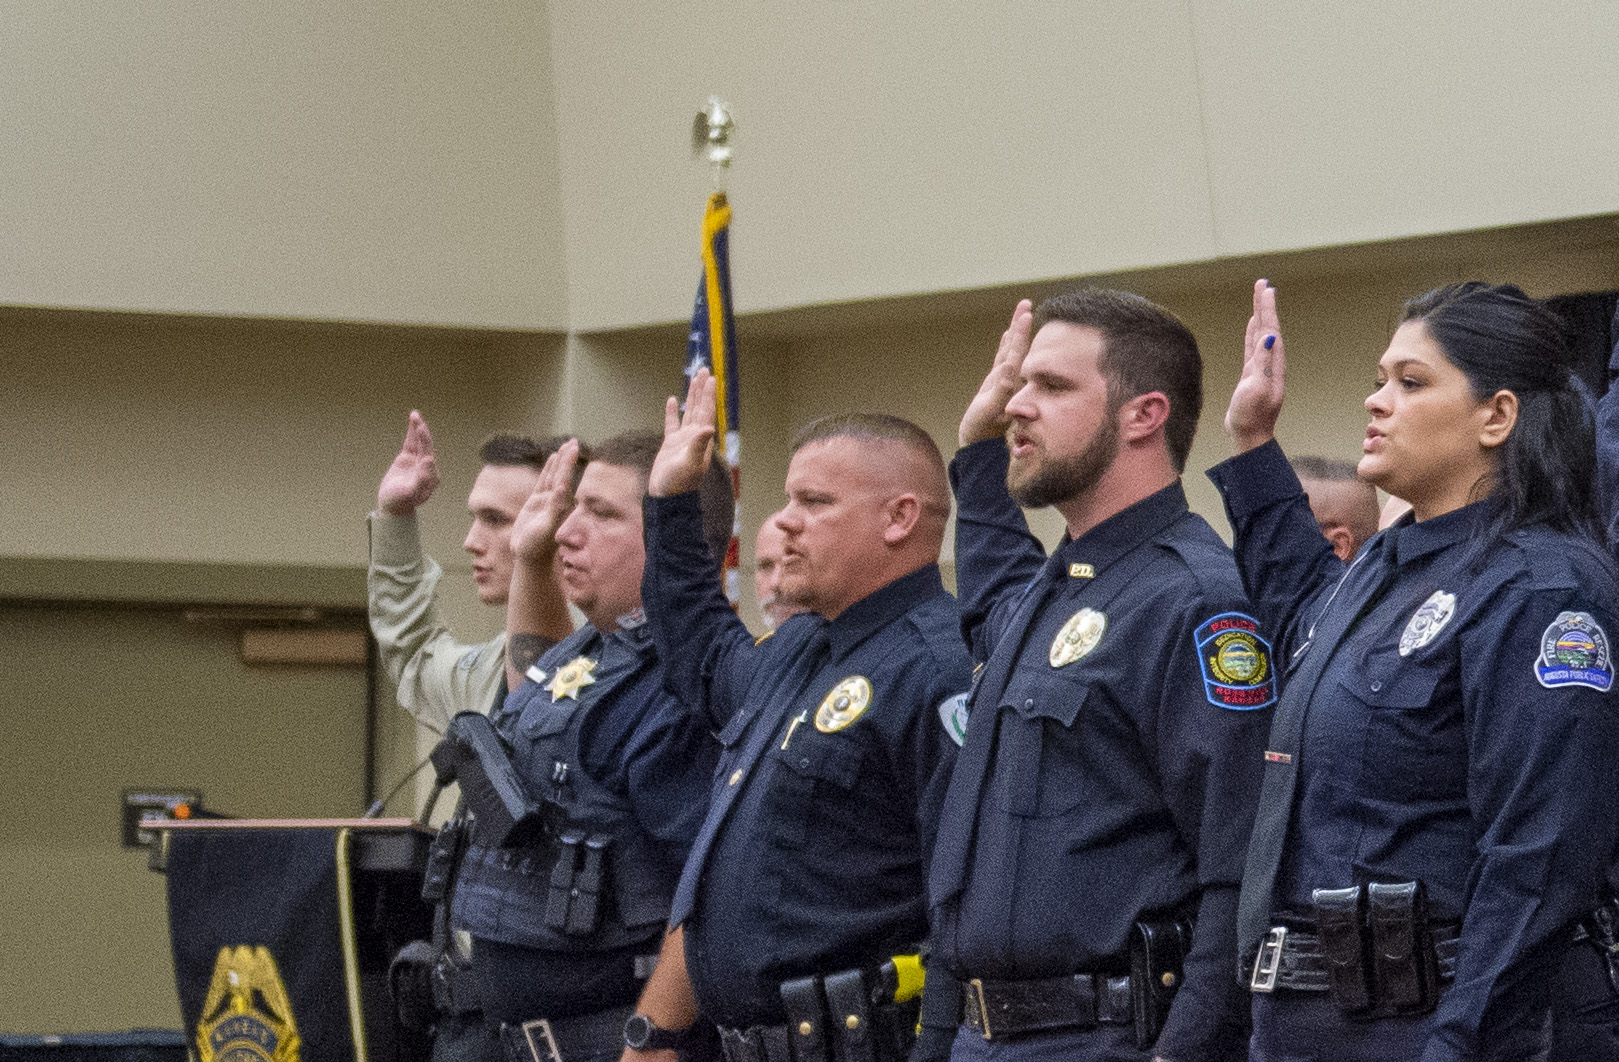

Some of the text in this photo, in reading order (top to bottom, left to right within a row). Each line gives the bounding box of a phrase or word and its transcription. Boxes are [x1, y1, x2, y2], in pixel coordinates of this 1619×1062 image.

[1211, 620, 1256, 633] POLICE
[1559, 622, 1595, 633] POLICE
[1546, 637, 1557, 659] FIRE
